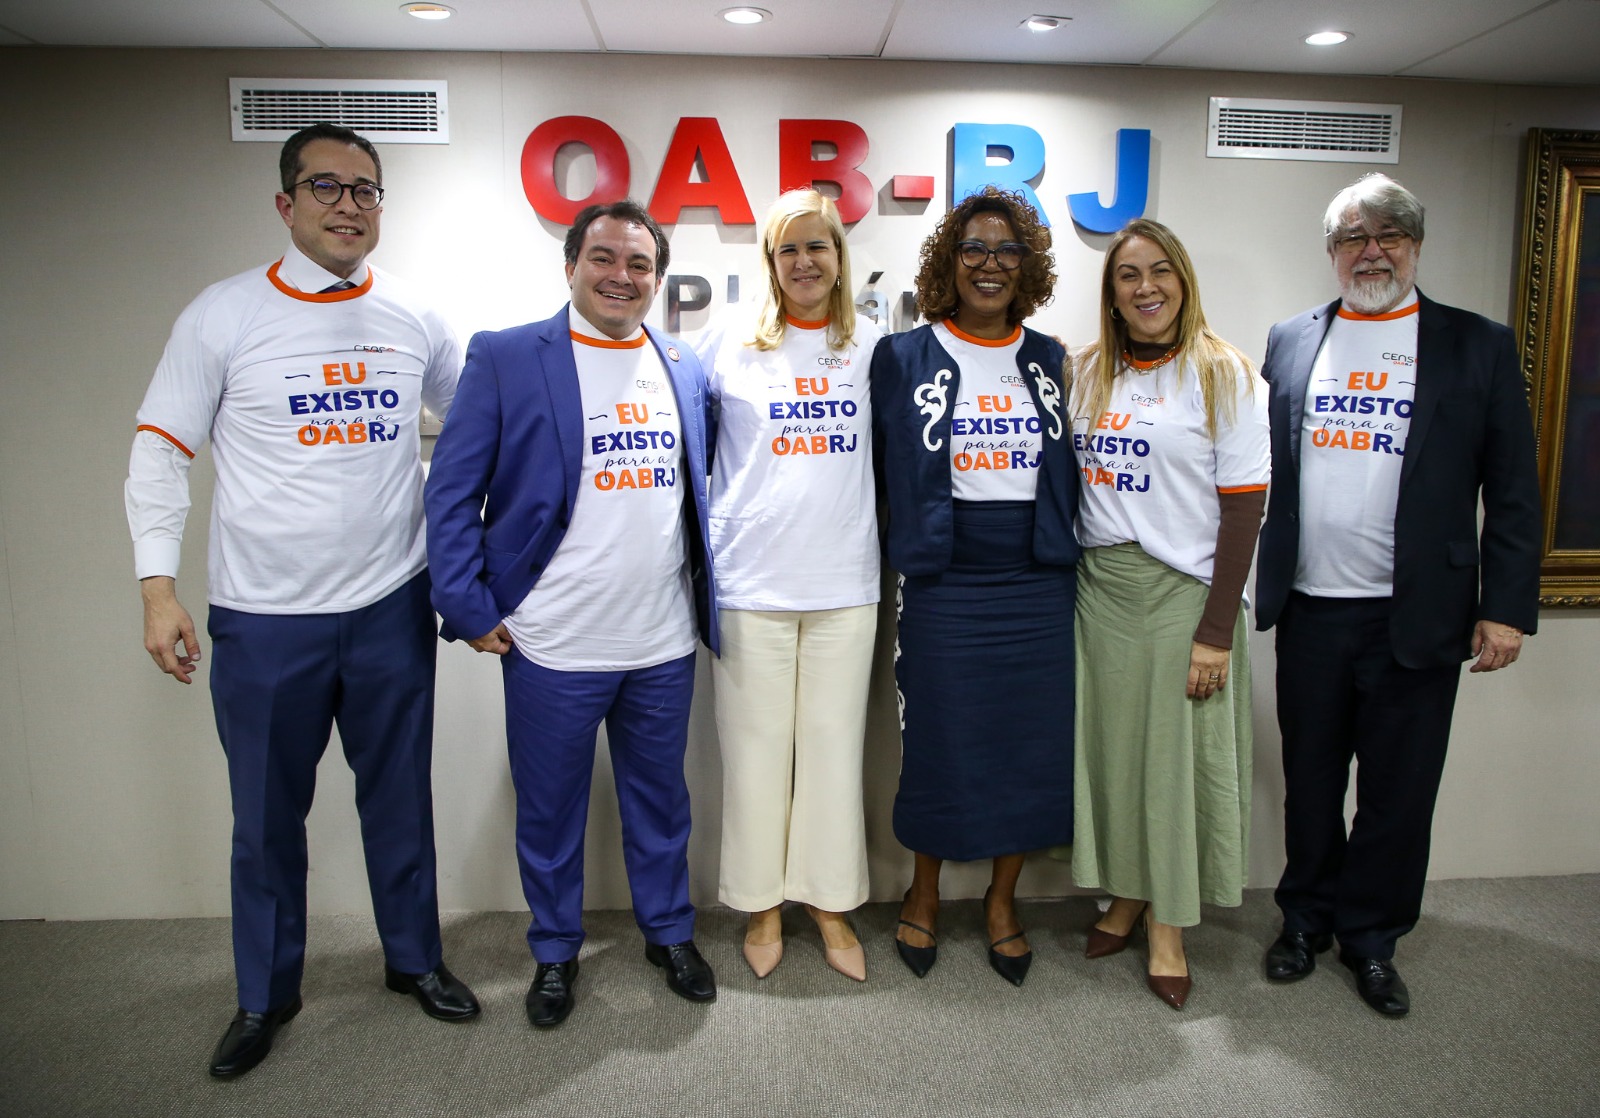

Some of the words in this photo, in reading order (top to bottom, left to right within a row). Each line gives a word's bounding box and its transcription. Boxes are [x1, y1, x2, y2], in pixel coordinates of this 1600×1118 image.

[520, 115, 1151, 233] OAB-RJ
[1382, 352, 1418, 363] CENS
[322, 362, 367, 386] EU
[1000, 376, 1026, 384] CENS
[1347, 372, 1389, 391] EU
[795, 377, 829, 396] EU
[288, 389, 399, 416] EXISTO
[615, 403, 649, 424] EU
[769, 400, 858, 420] EXISTO
[977, 395, 1013, 413] EU
[1315, 396, 1415, 419] EXISTO
[952, 416, 1043, 436] EXISTO
[1096, 411, 1132, 431] EU
[1321, 418, 1378, 440] para
[1384, 422, 1401, 431] a
[297, 421, 400, 446] OABRJ
[592, 430, 676, 455] EXISTO
[781, 424, 831, 448] para
[836, 423, 849, 431] a
[772, 434, 858, 456] OABRJ
[964, 441, 1015, 464] para
[1019, 440, 1035, 448] a
[1073, 433, 1151, 458] EXISTO
[605, 456, 655, 482] para
[658, 455, 670, 464] a
[953, 450, 1044, 472] OABRJ
[1125, 462, 1140, 470] a
[594, 467, 676, 491] OABRJ
